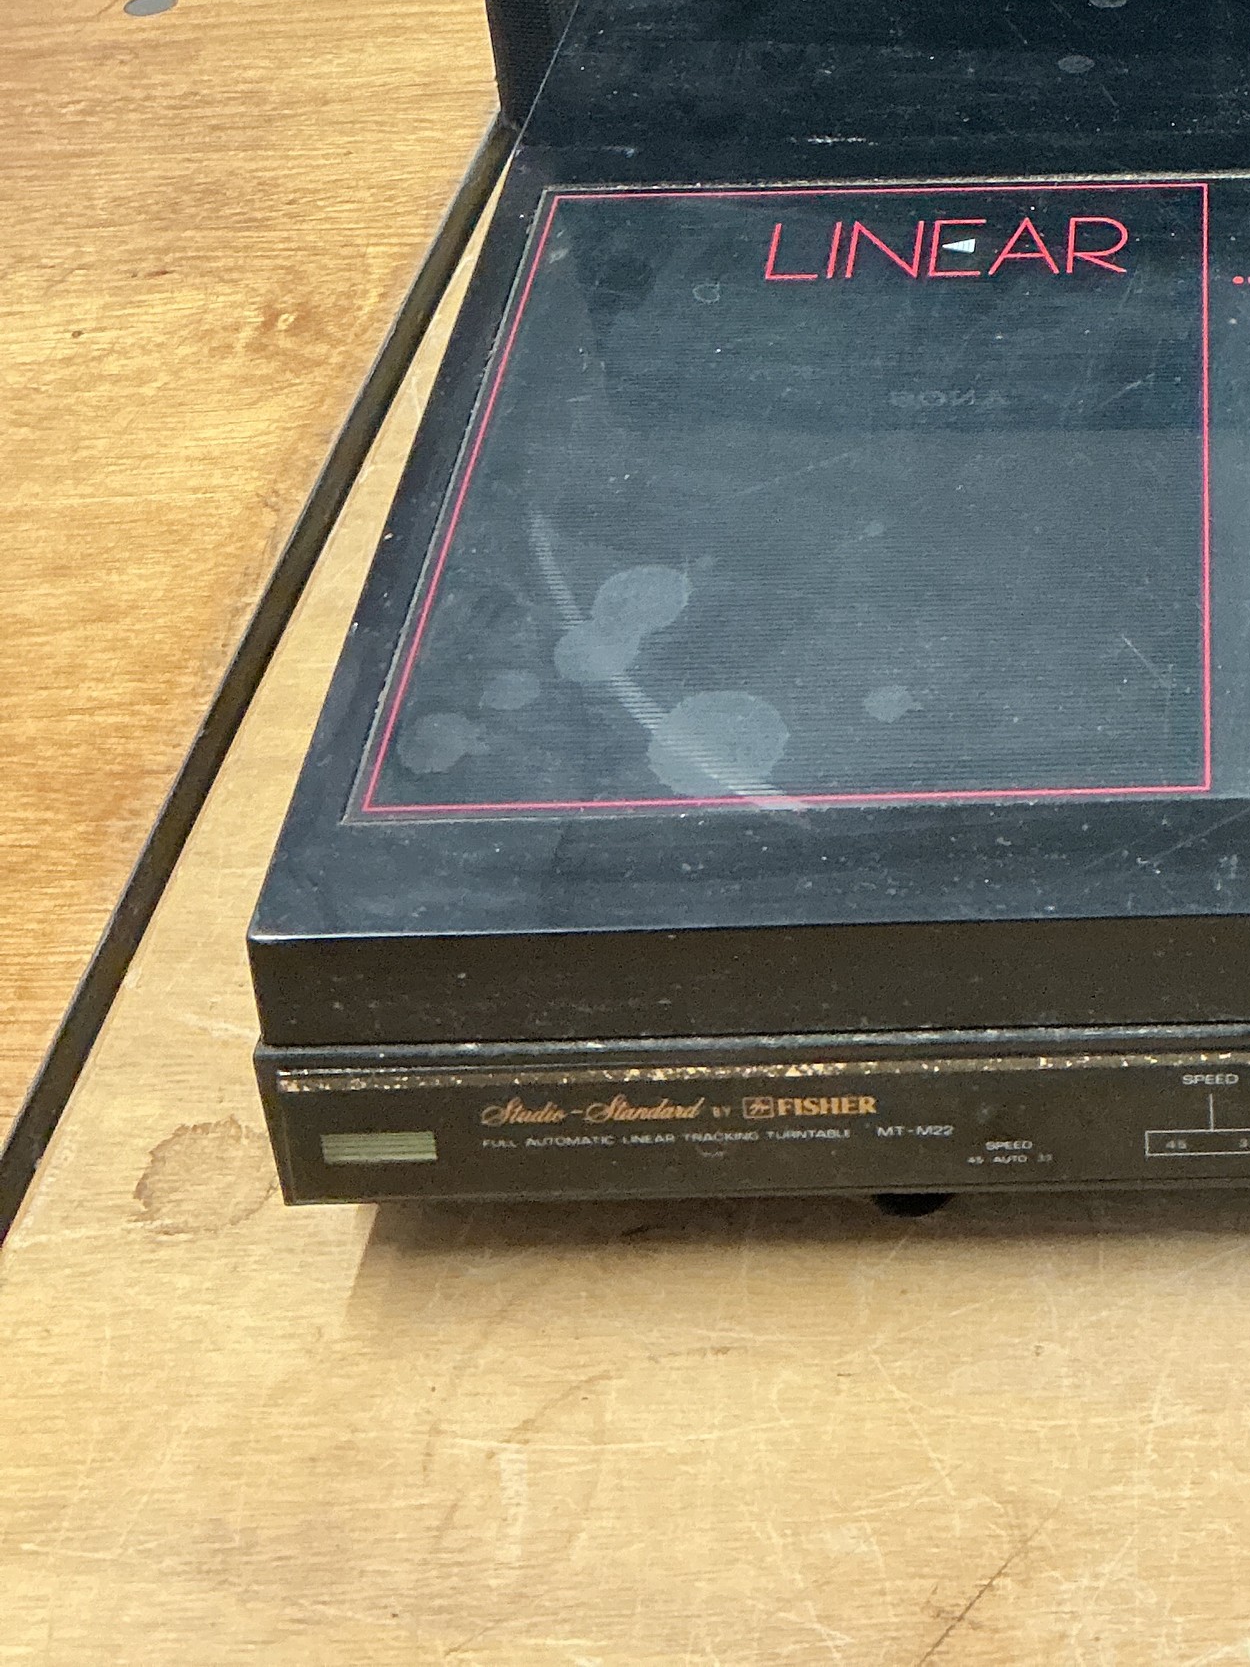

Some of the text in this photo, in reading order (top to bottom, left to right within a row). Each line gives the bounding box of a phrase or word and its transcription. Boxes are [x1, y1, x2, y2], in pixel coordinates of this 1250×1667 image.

[765, 217, 1128, 280] LINEAR
[1182, 1074, 1239, 1085] SPEED
[777, 1096, 878, 1116] FISHER
[526, 1136, 617, 1147] AUTOMATIC
[623, 1134, 676, 1145] LINEAR
[684, 1130, 760, 1142] TRACKING
[767, 1129, 851, 1140] TURNTABLE
[985, 1140, 1033, 1151] SPEED
